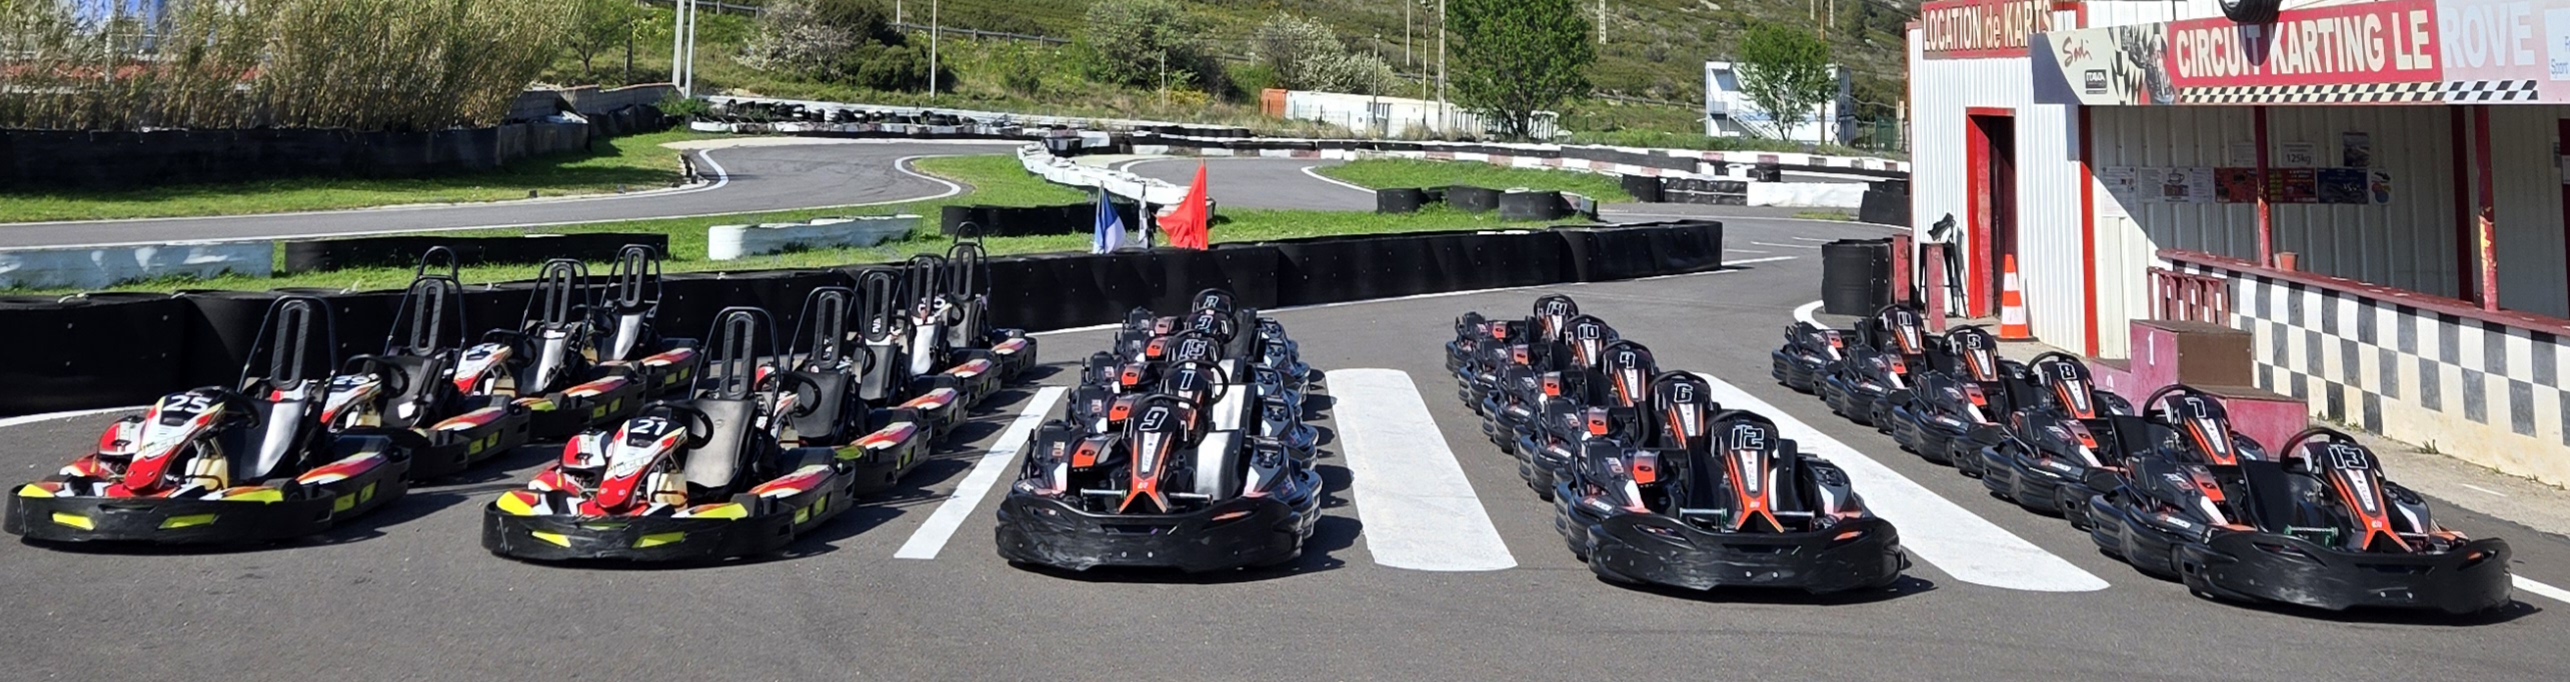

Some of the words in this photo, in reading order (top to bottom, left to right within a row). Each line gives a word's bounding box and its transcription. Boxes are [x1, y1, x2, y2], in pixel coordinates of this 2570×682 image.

[1923, 5, 1982, 51] LOCATION
[1985, 12, 2000, 48] de
[2004, 0, 2051, 47] KARTS
[2176, 24, 2261, 79] CIRCUIT
[2268, 12, 2386, 75] KARTING
[2391, 9, 2433, 71] LE
[2440, 1, 2536, 69] ROVE
[1578, 323, 1599, 340] 10
[2148, 330, 2155, 366] 1
[1620, 351, 1636, 369] 4
[1180, 370, 1197, 390] 1
[2056, 362, 2078, 380] 8
[1674, 383, 1694, 402] 6
[162, 394, 213, 414] 25
[2184, 396, 2207, 418] 7
[630, 419, 668, 436] 21
[1139, 406, 1169, 431] 9
[1731, 424, 1765, 450] 12
[2328, 444, 2369, 469] 13
